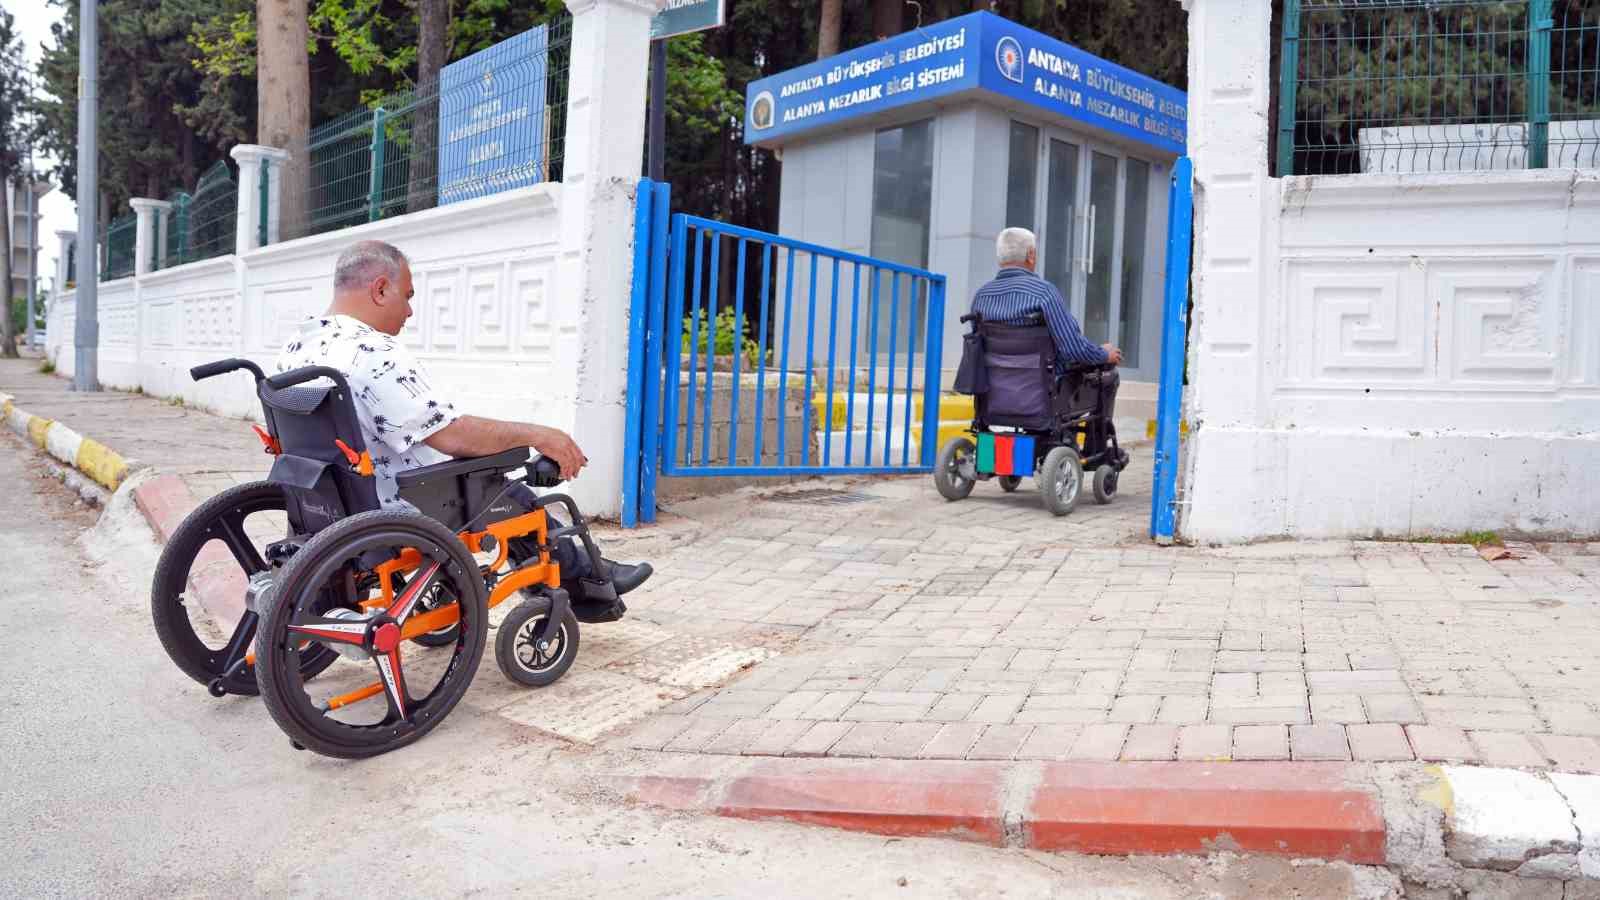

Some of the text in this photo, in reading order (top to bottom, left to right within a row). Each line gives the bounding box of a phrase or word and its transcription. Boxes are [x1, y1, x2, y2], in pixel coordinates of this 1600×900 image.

[781, 77, 823, 98] ANTALYA
[900, 28, 965, 64] BELEDİYESİ
[783, 99, 826, 122] ALANYA
[829, 84, 882, 111] MEZARLIK
[917, 58, 964, 87] SİSTEMİ
[1028, 48, 1081, 83] ANTALYA
[1034, 77, 1082, 108] ALANYA
[1086, 97, 1140, 128] MEZARLIK
